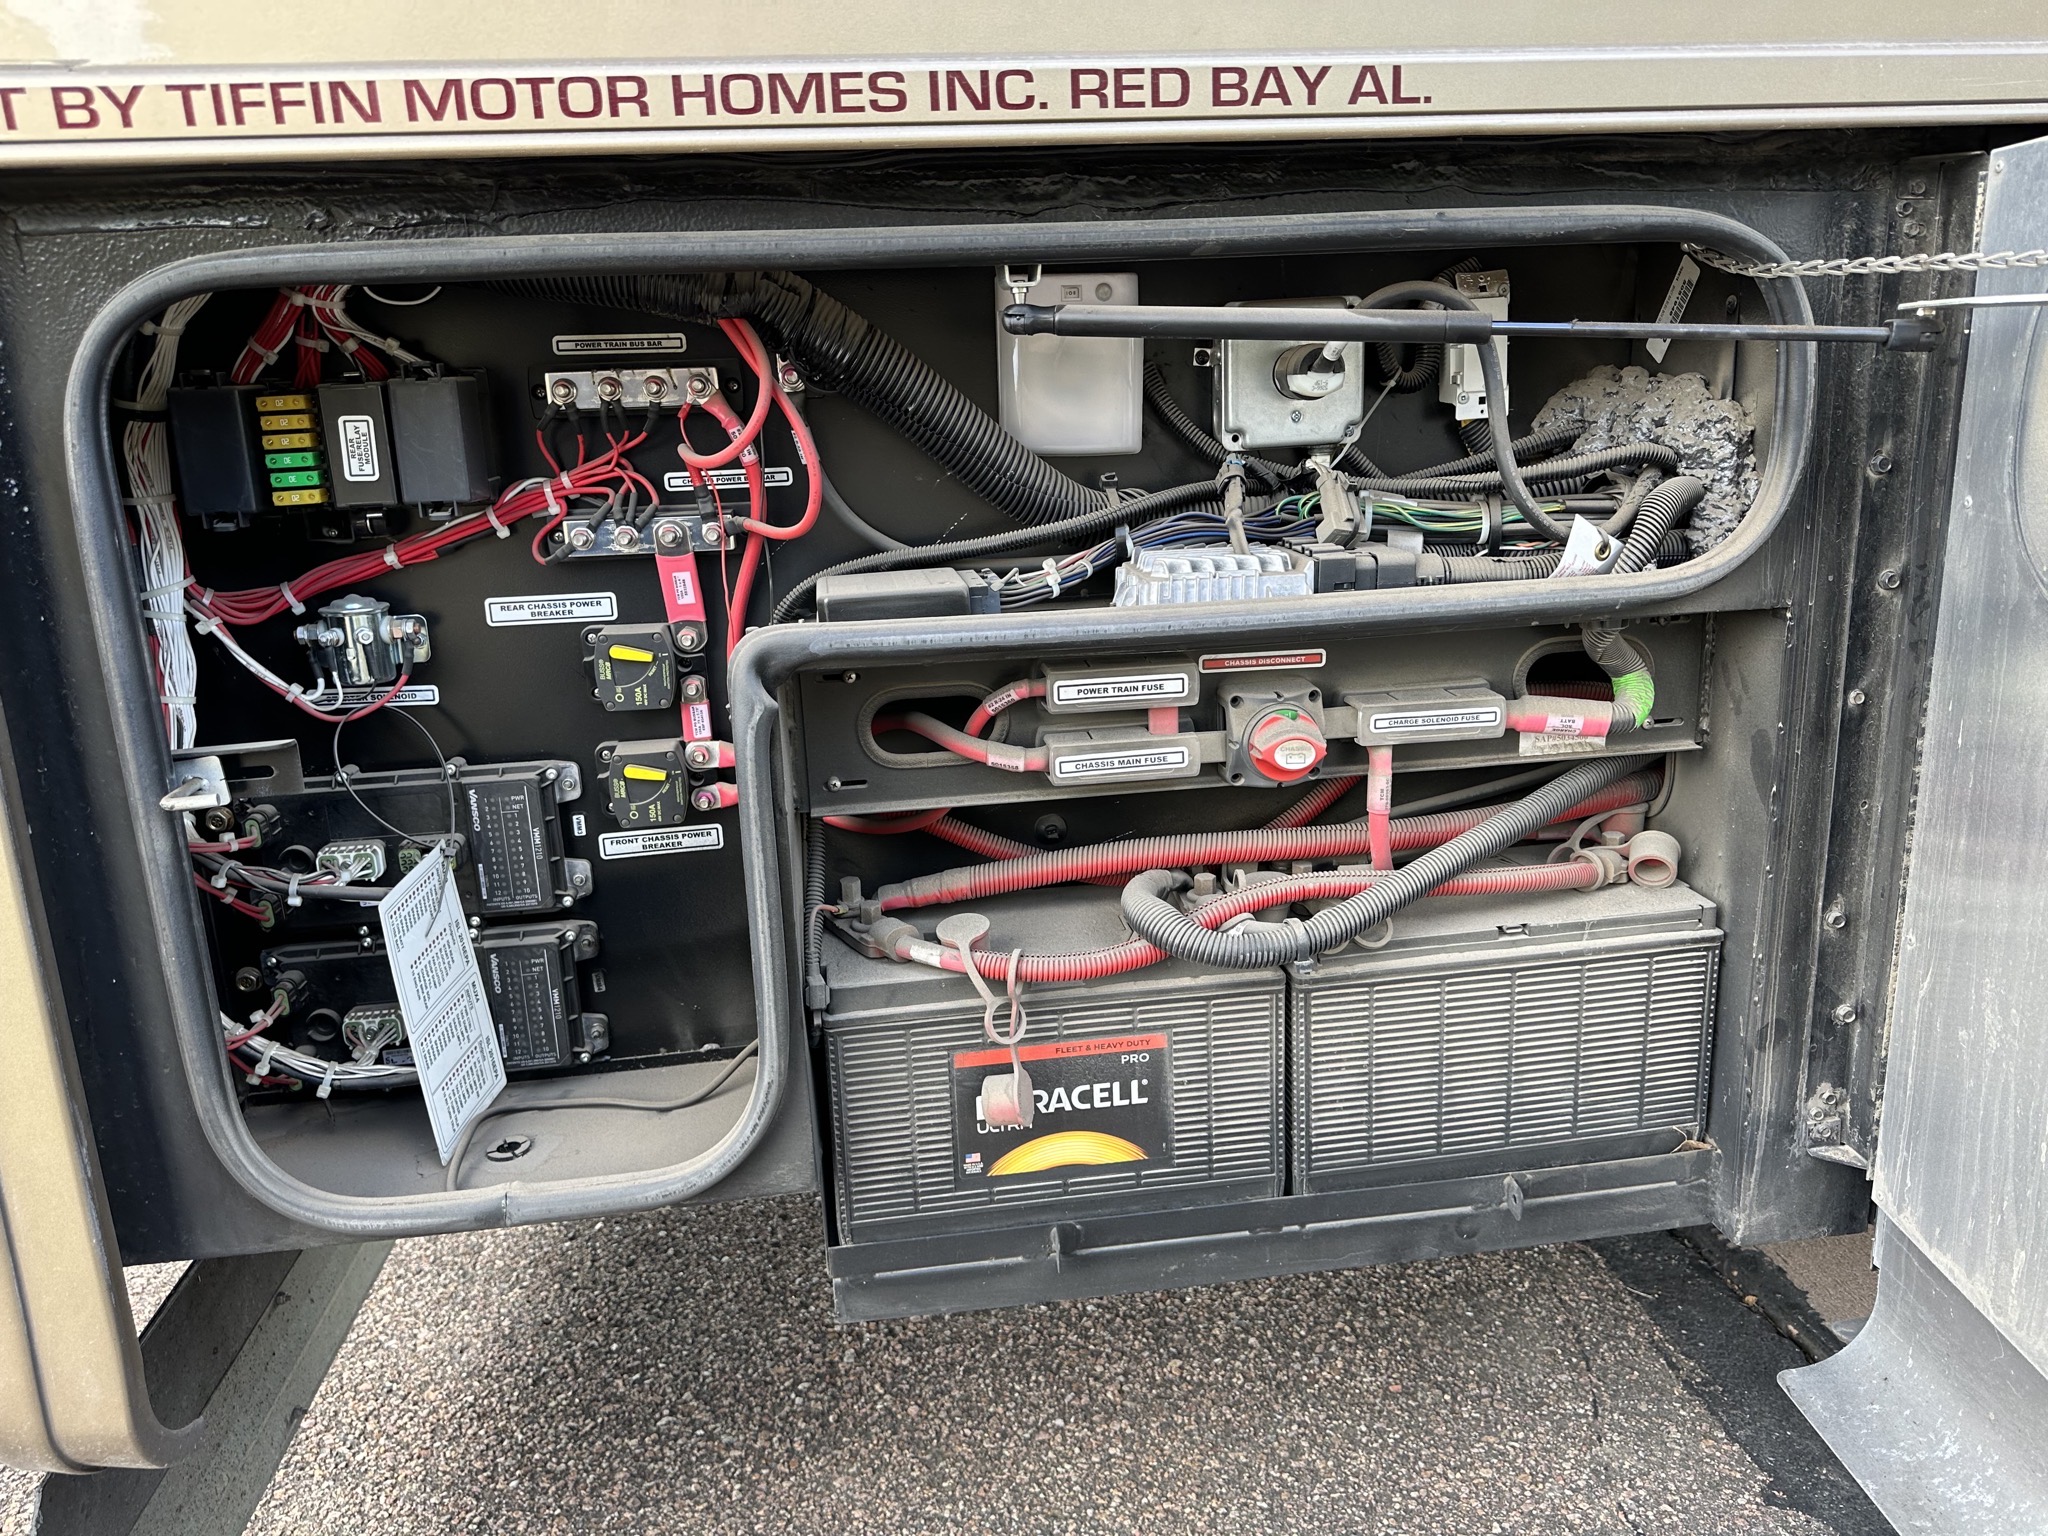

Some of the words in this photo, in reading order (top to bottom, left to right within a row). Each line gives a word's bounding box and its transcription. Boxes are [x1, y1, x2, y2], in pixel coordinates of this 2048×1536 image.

[51, 85, 145, 129] BY
[165, 80, 380, 128] TIFFIN
[404, 76, 650, 122] MOTOR
[672, 71, 907, 117] HOMES
[928, 69, 1048, 112] INC.
[1070, 67, 1190, 110] RED
[1211, 65, 1332, 108] BAY
[1348, 65, 1433, 106] AL.
[361, 432, 371, 465] MODULE
[716, 475, 742, 483] POWER
[500, 604, 525, 612] REAR
[527, 602, 567, 610] CHASSIS
[569, 600, 602, 608] POWER
[530, 609, 574, 618] BREAKER
[1259, 656, 1306, 665] DISCONNECT
[1077, 687, 1109, 696] POWER
[1111, 685, 1139, 693] TRAIN
[1388, 718, 1419, 726] CHARGE
[1421, 716, 1459, 724] SOLENOID
[1075, 760, 1115, 770] CHASSIS
[1118, 758, 1142, 766] MAIN
[1145, 756, 1169, 764] FUSE
[468, 789, 481, 832] VANSCO
[648, 804, 657, 822] 150A
[532, 827, 543, 860] VMM1210
[610, 837, 639, 846] FRONT
[642, 834, 679, 842] CHASSIS
[681, 831, 712, 839] POWER
[642, 841, 683, 850] BREAKER
[458, 931, 470, 967] 2016EPA
[490, 953, 502, 994] VANSCO
[552, 988, 562, 1020] VMM1210
[470, 979, 480, 1004] MUX4
[484, 1034, 492, 1049] ISL
[1055, 1045, 1083, 1055] FLEET
[1094, 1042, 1123, 1050] HEAVY
[1126, 1039, 1151, 1047] DUTY
[1121, 1053, 1150, 1064] PRO
[976, 1079, 1149, 1121] RACELL
